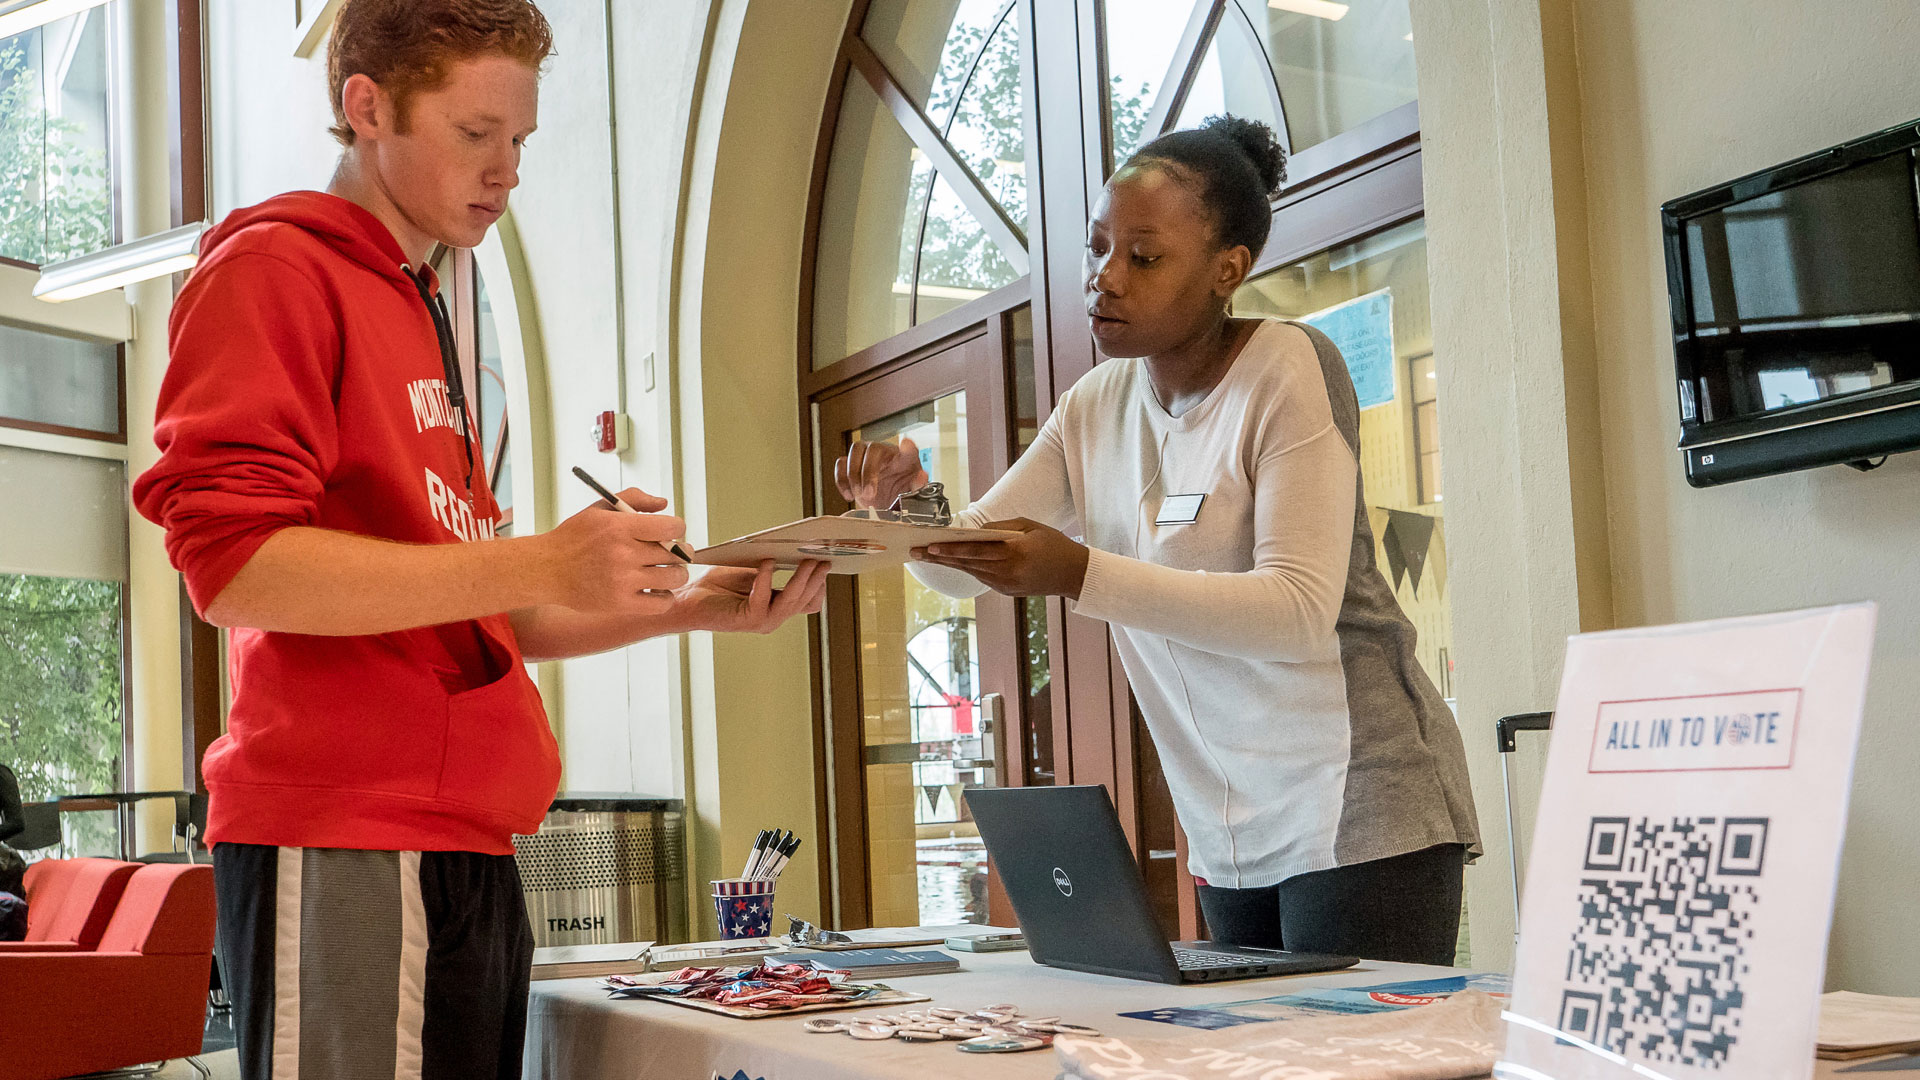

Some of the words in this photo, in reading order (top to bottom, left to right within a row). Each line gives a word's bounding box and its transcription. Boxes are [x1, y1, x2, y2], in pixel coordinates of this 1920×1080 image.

[1605, 720, 1641, 750] ALL
[1648, 718, 1672, 749] IN
[1679, 716, 1706, 747] TO
[547, 916, 605, 932] TRASH
